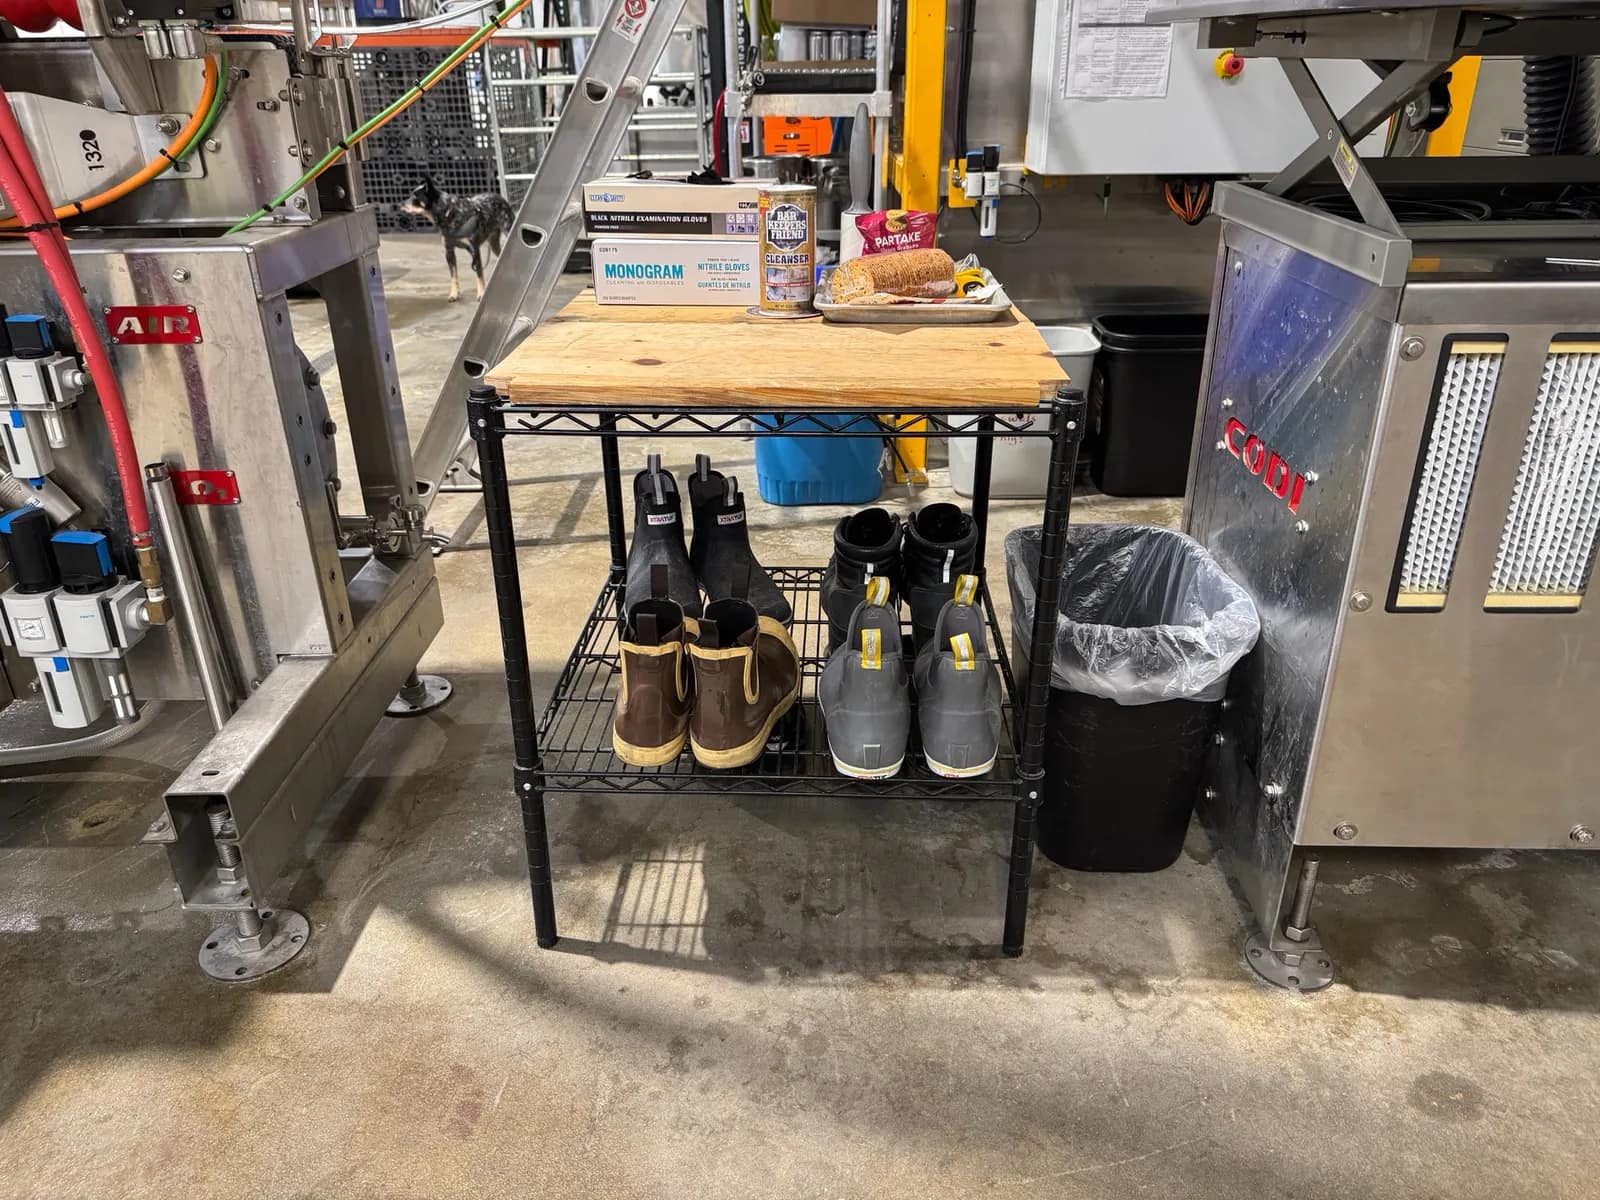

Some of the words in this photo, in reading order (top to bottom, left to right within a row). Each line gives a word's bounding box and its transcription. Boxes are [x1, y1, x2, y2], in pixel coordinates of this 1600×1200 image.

[636, 215, 681, 223] EXAMINATION
[777, 211, 797, 221] BAR
[768, 220, 806, 230] KEEPERS
[771, 229, 804, 240] FRIEND
[874, 231, 921, 248] PARTAKE
[765, 254, 809, 264] CLEANSER
[605, 263, 684, 279] MONOGRAM
[697, 263, 722, 271] NITRILE
[724, 263, 750, 271] GLOVES
[117, 315, 192, 335] AIR
[1224, 416, 1306, 516] CODI
